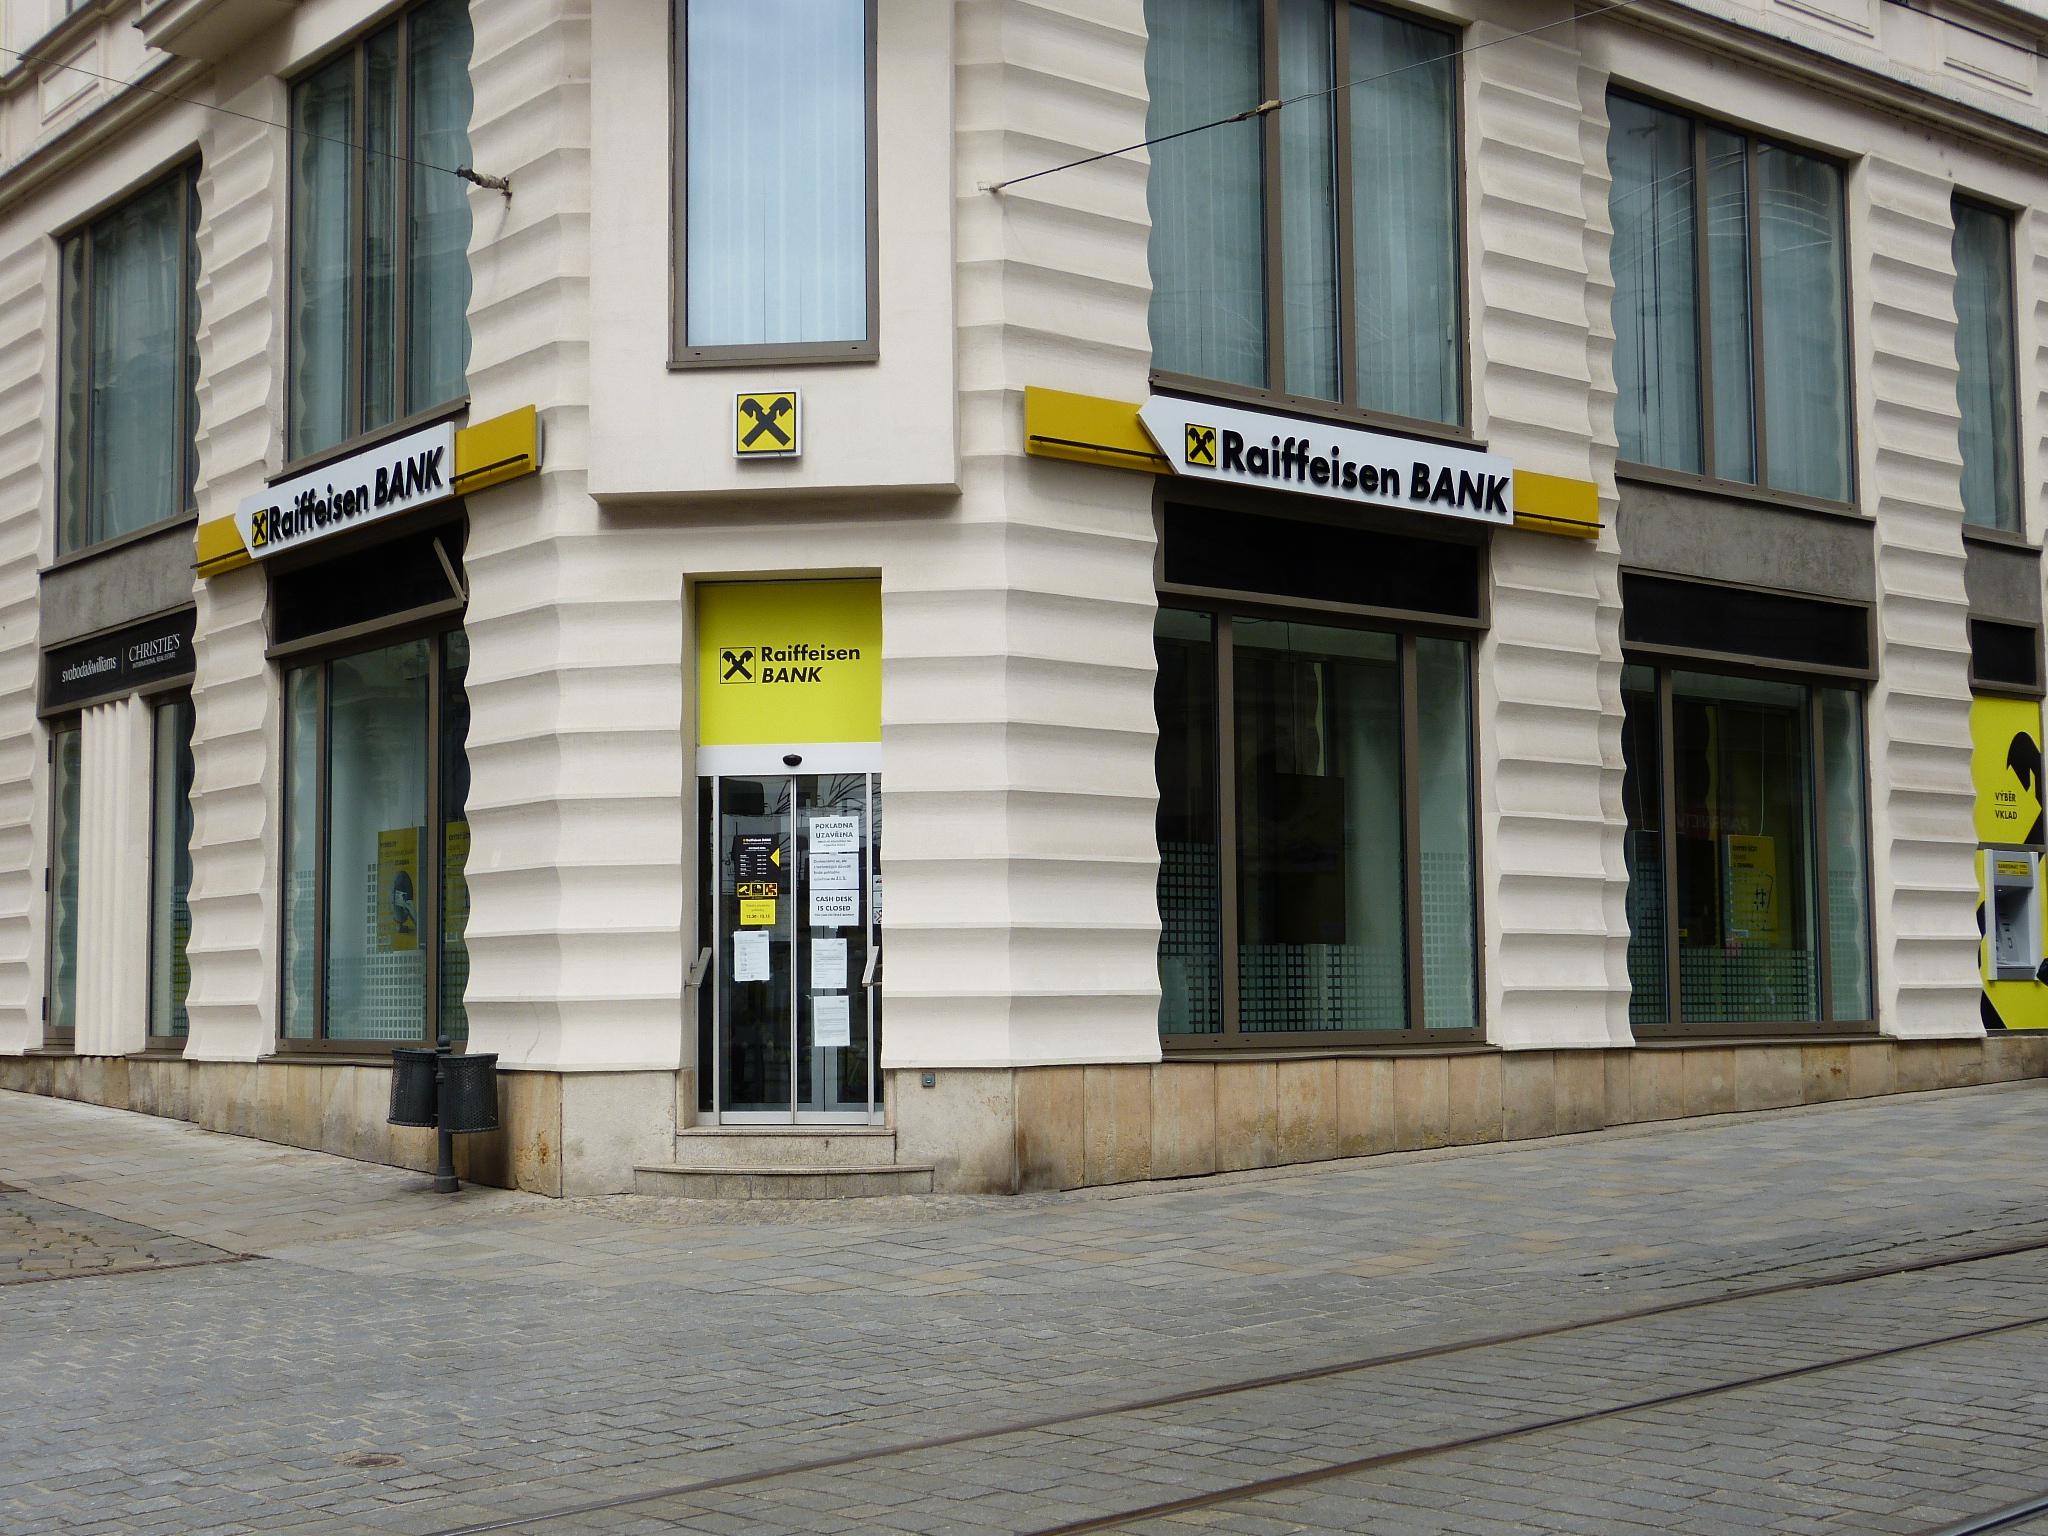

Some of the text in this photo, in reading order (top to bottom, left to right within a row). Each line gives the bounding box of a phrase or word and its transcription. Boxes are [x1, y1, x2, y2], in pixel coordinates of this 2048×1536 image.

[1222, 429, 1510, 513] Raiffeisen BANK
[268, 445, 445, 542] Raiffeisen BANK
[128, 633, 180, 662] CHRISTIE'S
[761, 643, 860, 662] Raiffeisen
[761, 666, 823, 684] BANK
[1995, 810, 2018, 820] VKLAD
